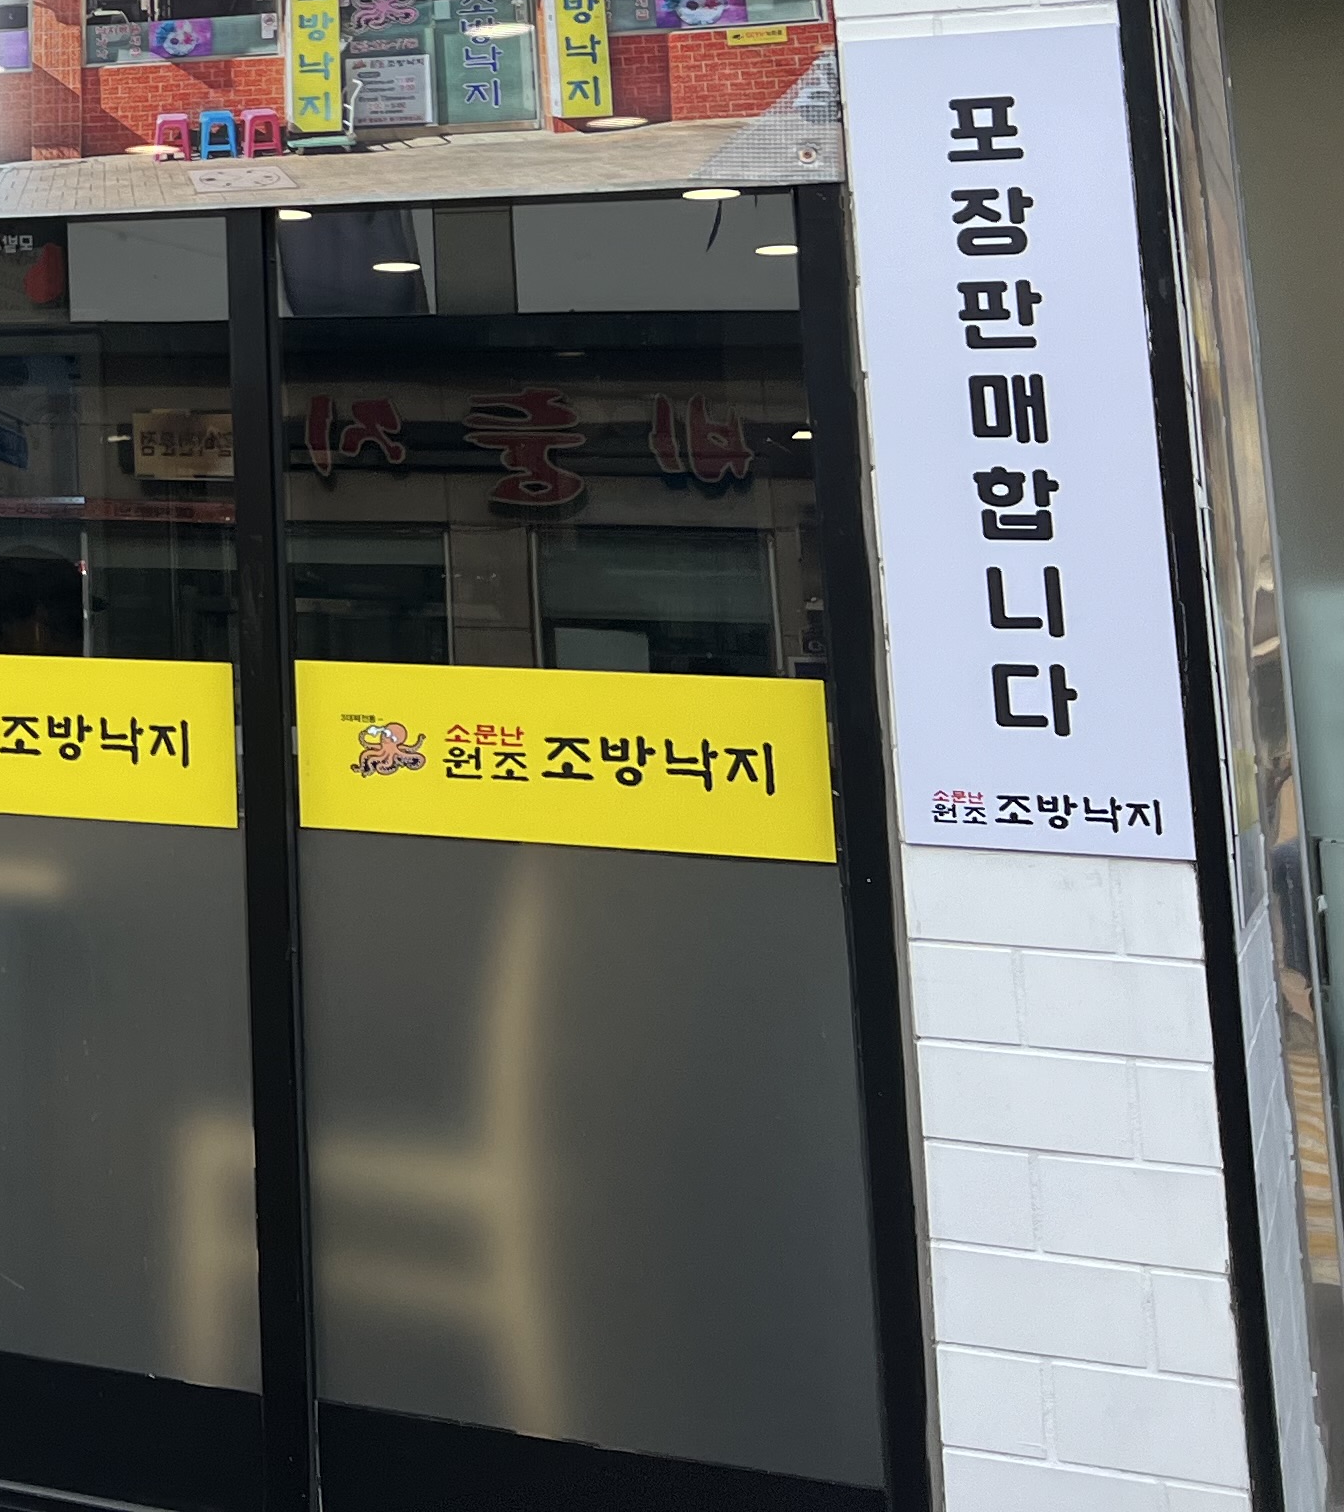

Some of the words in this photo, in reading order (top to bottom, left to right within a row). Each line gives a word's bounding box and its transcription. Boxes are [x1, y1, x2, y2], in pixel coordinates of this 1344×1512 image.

[947, 95, 1078, 737] 포장판매합니다
[444, 723, 524, 747] 소문난
[441, 746, 530, 783] 원조
[541, 735, 777, 797] 조방낙지
[931, 804, 988, 826] 원조
[994, 794, 1164, 836] 조방낙지
[932, 790, 984, 805] 소문난
